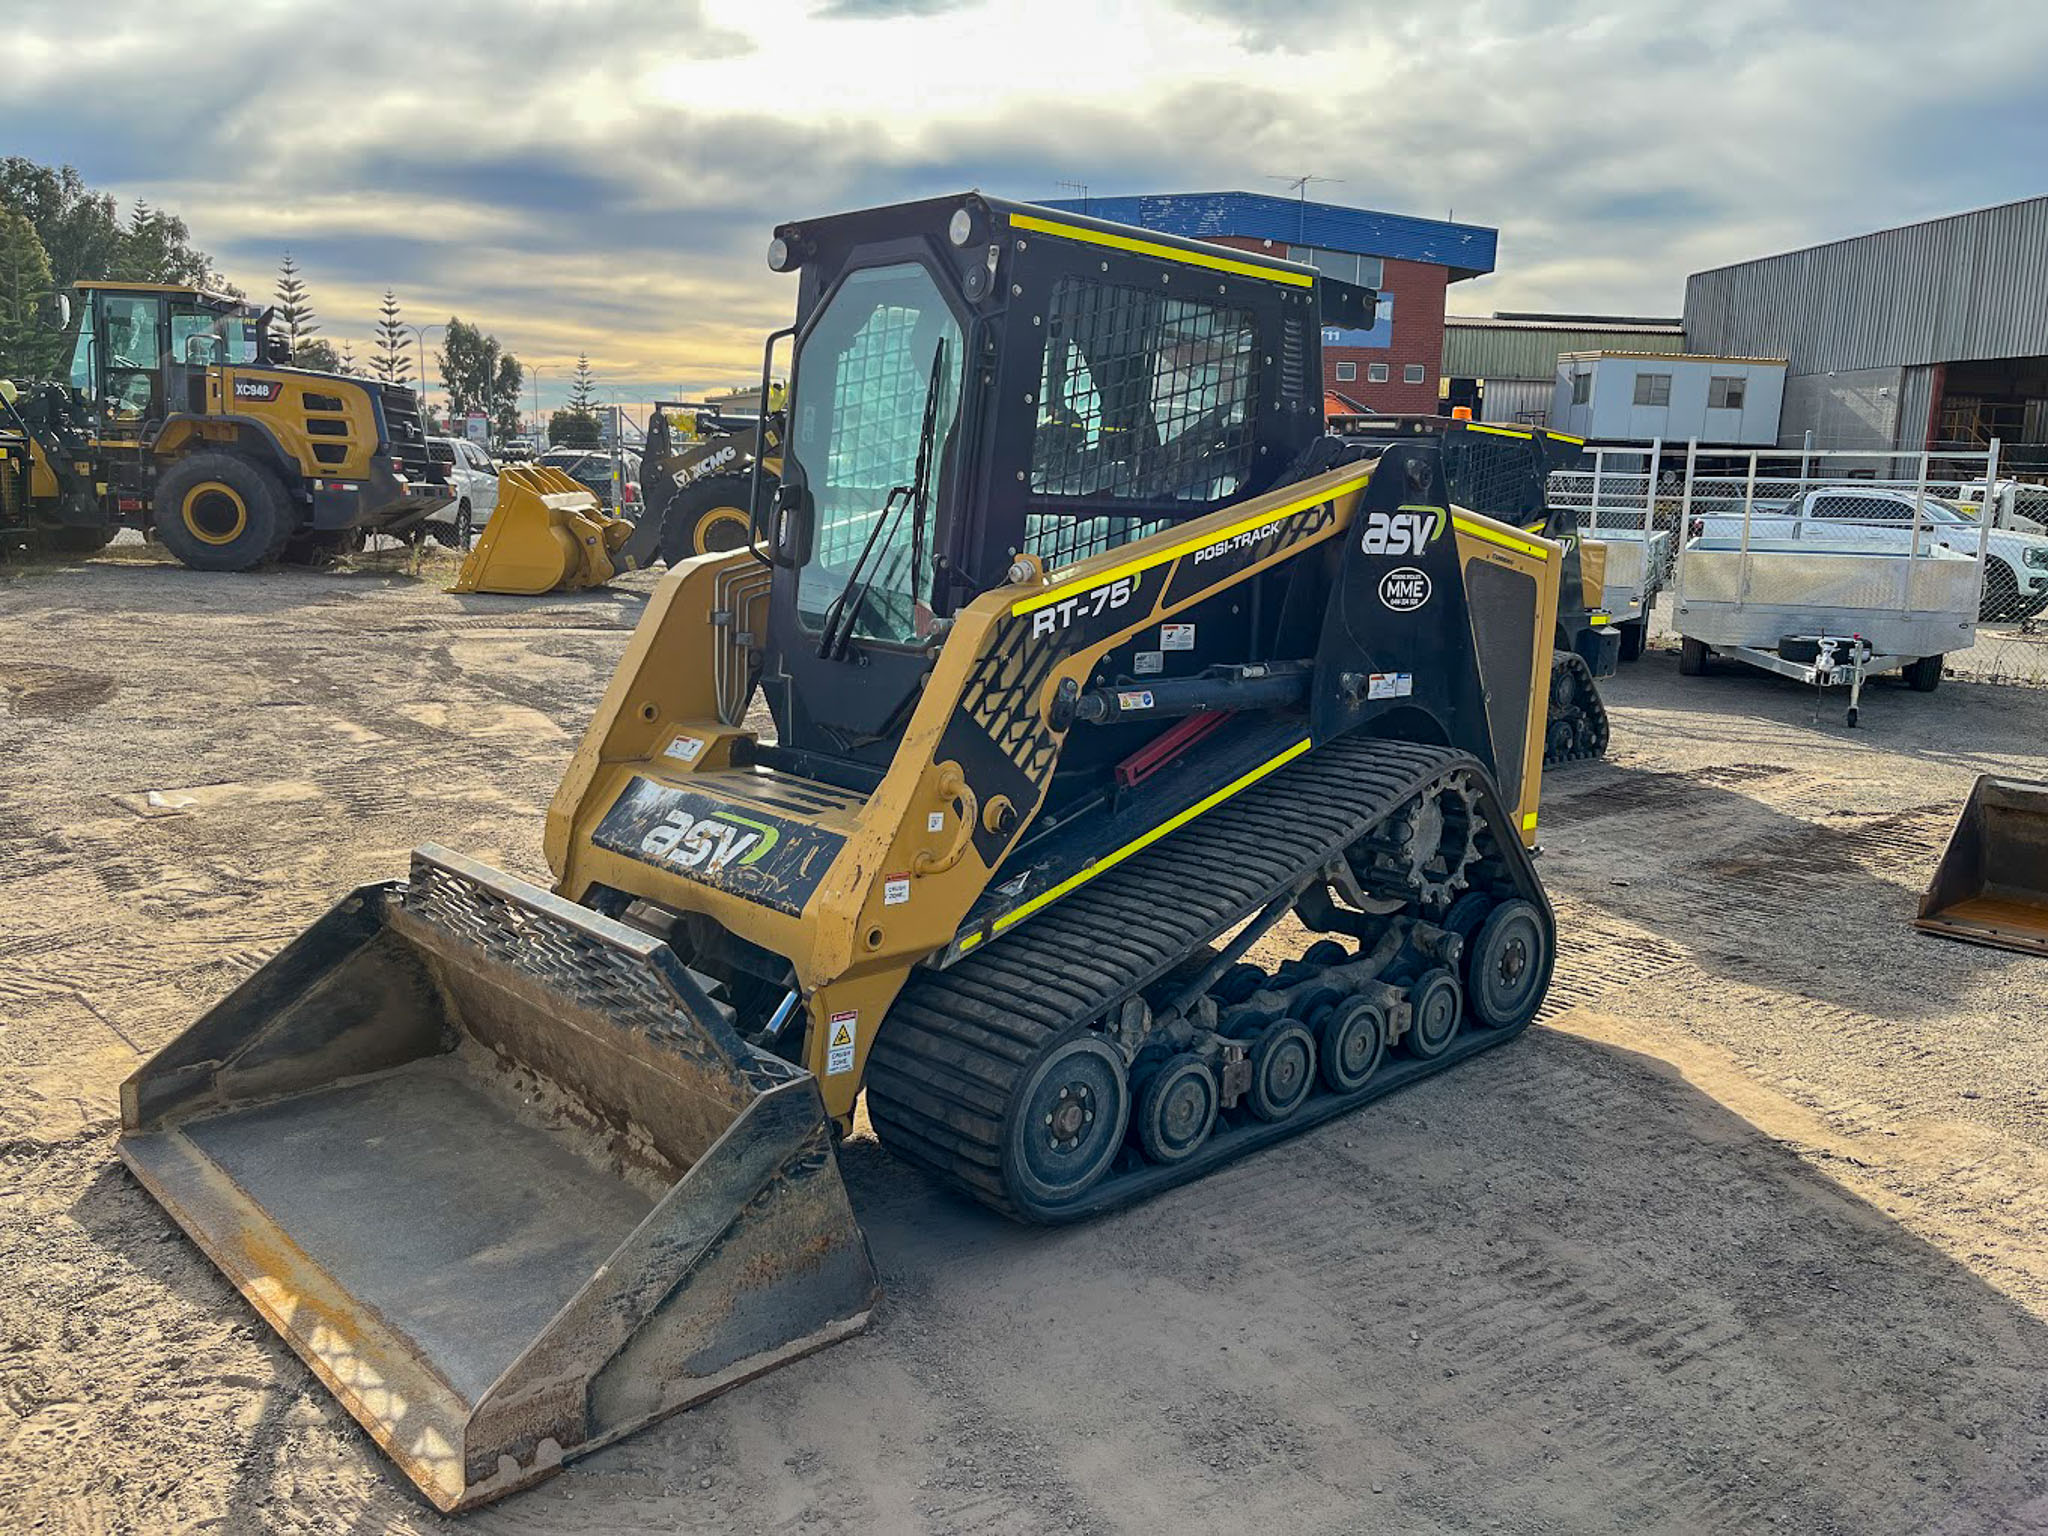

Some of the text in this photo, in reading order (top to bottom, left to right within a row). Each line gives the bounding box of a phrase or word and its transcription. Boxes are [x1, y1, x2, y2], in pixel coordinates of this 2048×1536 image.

[235, 383, 270, 397] XC948
[688, 445, 737, 479] XCMG
[1194, 521, 1280, 565] POSI-TRACK
[1386, 580, 1424, 598] MME
[1032, 577, 1132, 640] RT-75
